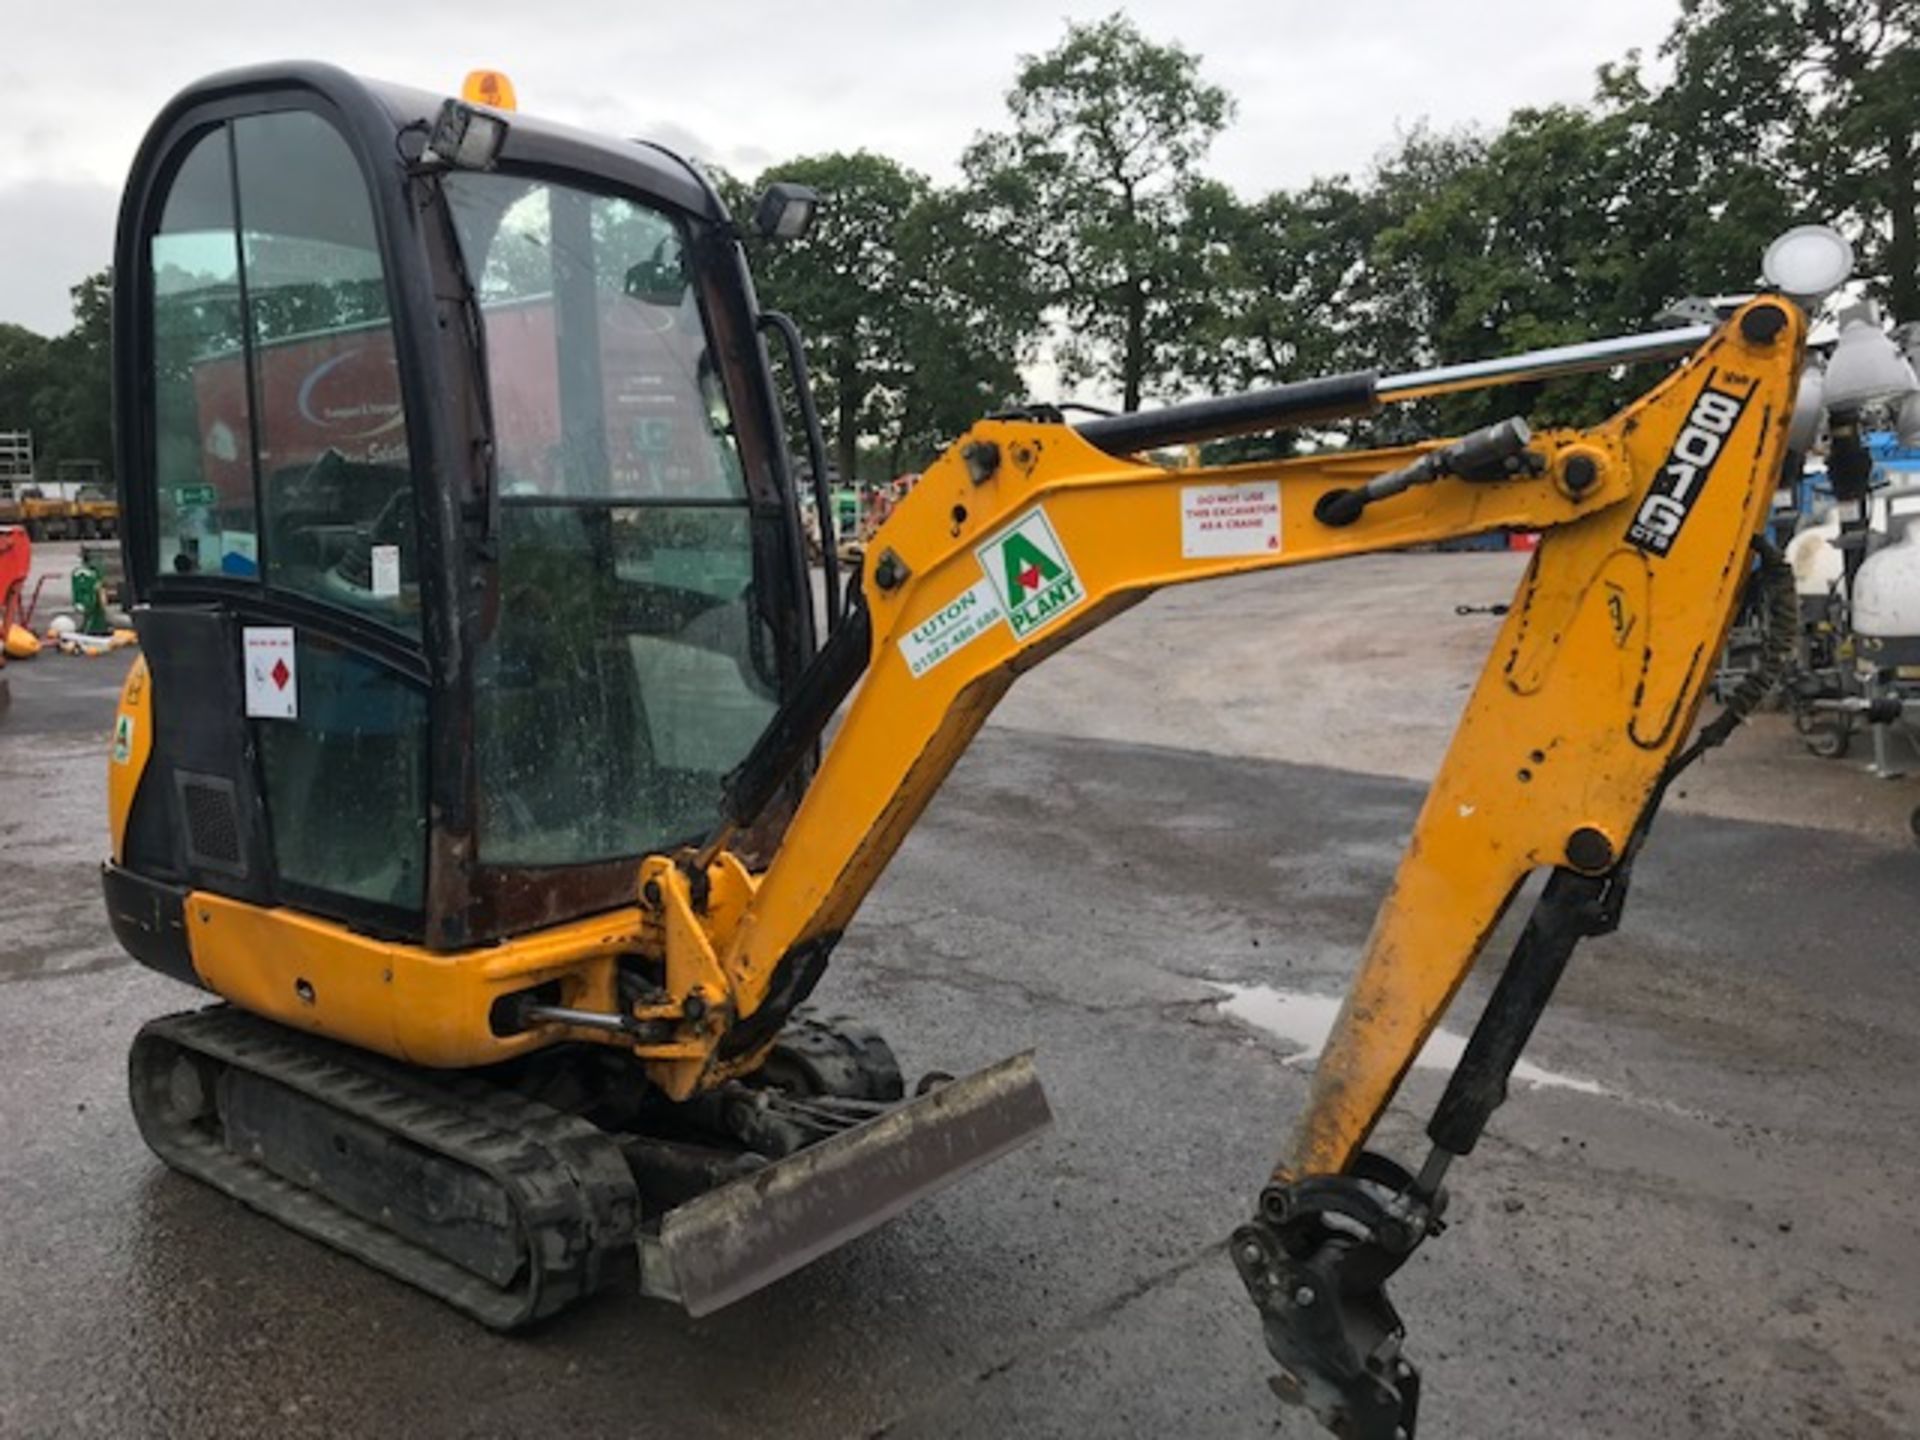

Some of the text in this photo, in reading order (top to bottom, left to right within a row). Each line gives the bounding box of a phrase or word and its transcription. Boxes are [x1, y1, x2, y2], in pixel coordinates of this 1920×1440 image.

[1637, 391, 1741, 537] 8016
[1185, 504, 1277, 518] THIS EXCAVATOR
[1197, 491, 1264, 505] DO NOT USE
[1225, 518, 1263, 530] CRANE
[1001, 530, 1064, 611] A
[911, 590, 977, 644] LUTON
[1010, 577, 1077, 632] PLANT
